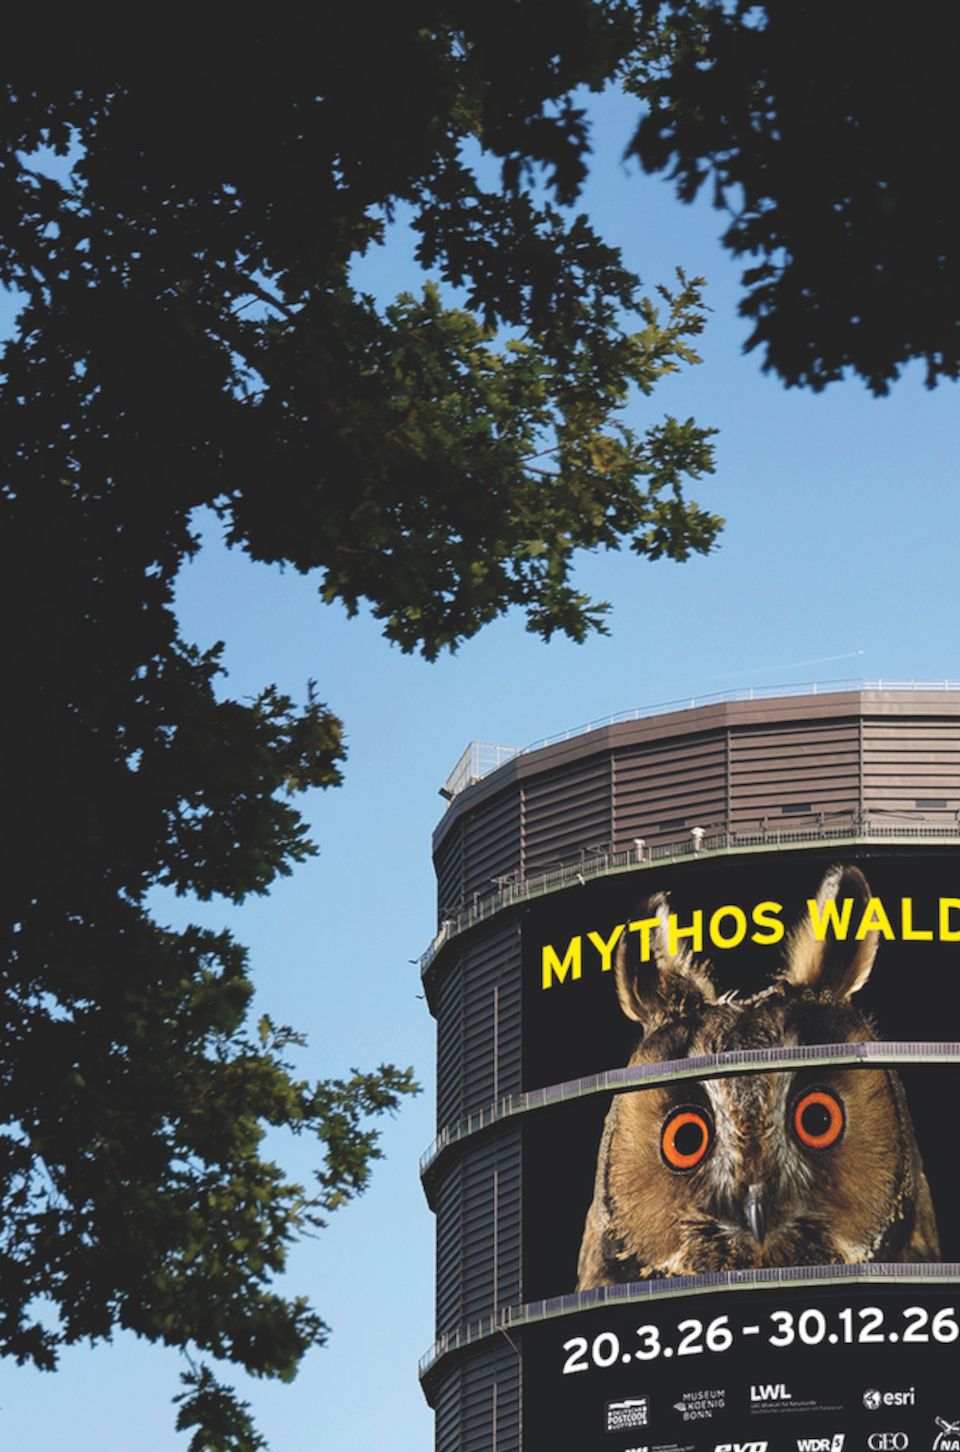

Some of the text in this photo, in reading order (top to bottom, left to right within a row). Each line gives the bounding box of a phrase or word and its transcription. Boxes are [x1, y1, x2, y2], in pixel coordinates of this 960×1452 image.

[542, 900, 785, 990] MYTHOS
[562, 1315, 734, 1375] 20.3.26
[768, 1307, 960, 1347] 30.12.26
[682, 1389, 725, 1401] MUSEUM
[750, 1384, 792, 1401] LWL
[883, 1387, 915, 1406] esri
[687, 1398, 725, 1410] KOENIG
[683, 1410, 713, 1421] BONN
[867, 1431, 909, 1451] GEO
